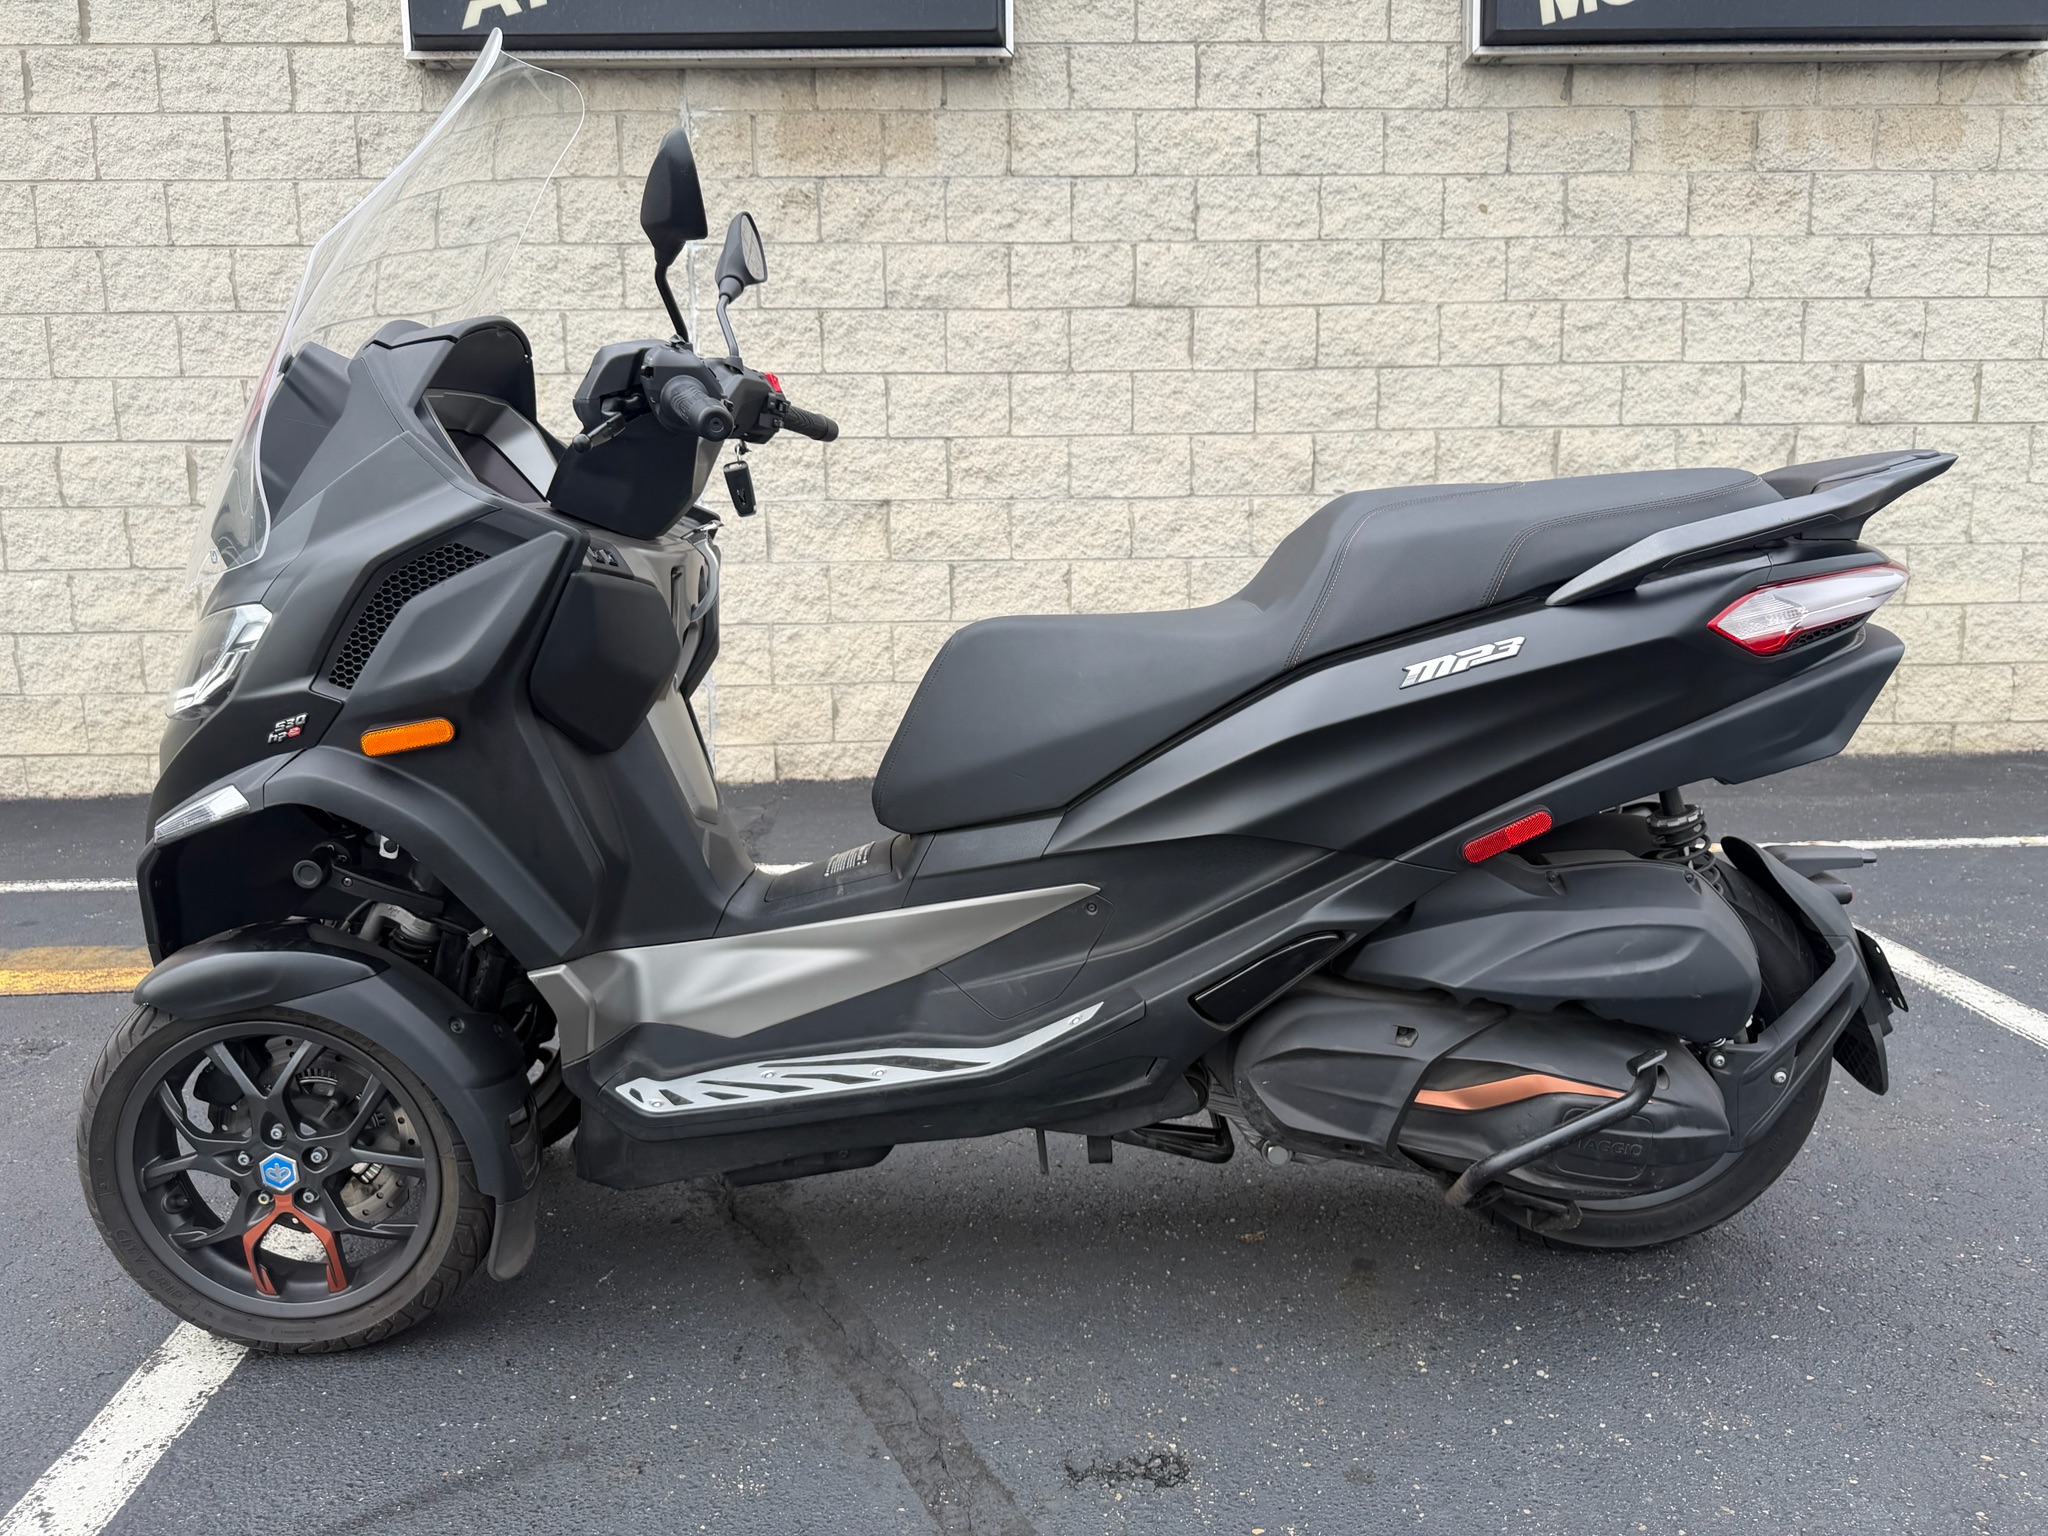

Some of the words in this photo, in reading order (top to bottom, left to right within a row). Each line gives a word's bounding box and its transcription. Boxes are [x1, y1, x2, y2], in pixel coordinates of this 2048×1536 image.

[1399, 636, 1526, 690] MP3
[274, 712, 308, 732] 530
[1577, 1138, 1643, 1156] IAGGIO
